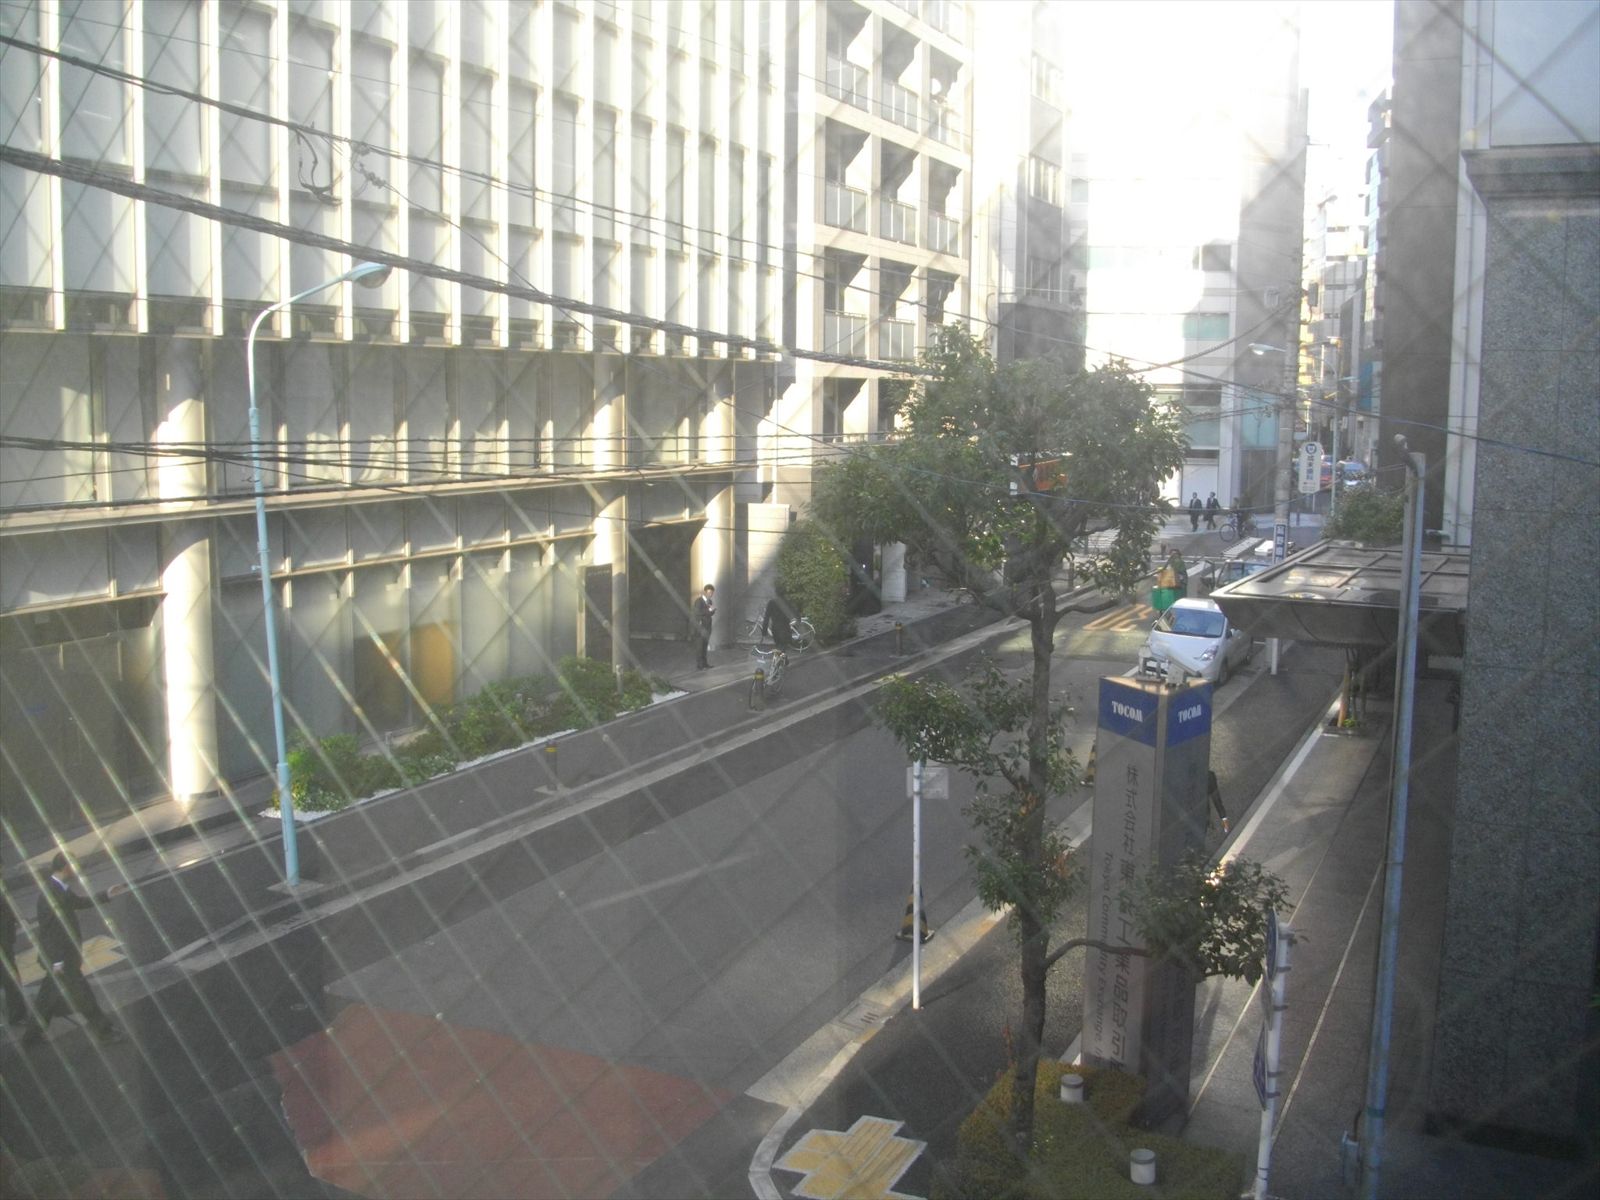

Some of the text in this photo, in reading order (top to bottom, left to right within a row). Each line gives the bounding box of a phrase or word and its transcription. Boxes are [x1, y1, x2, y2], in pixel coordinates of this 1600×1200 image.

[1111, 700, 1143, 723] TOCOM
[1177, 704, 1202, 724] TOCOM
[1102, 851, 1114, 891] Tokyo
